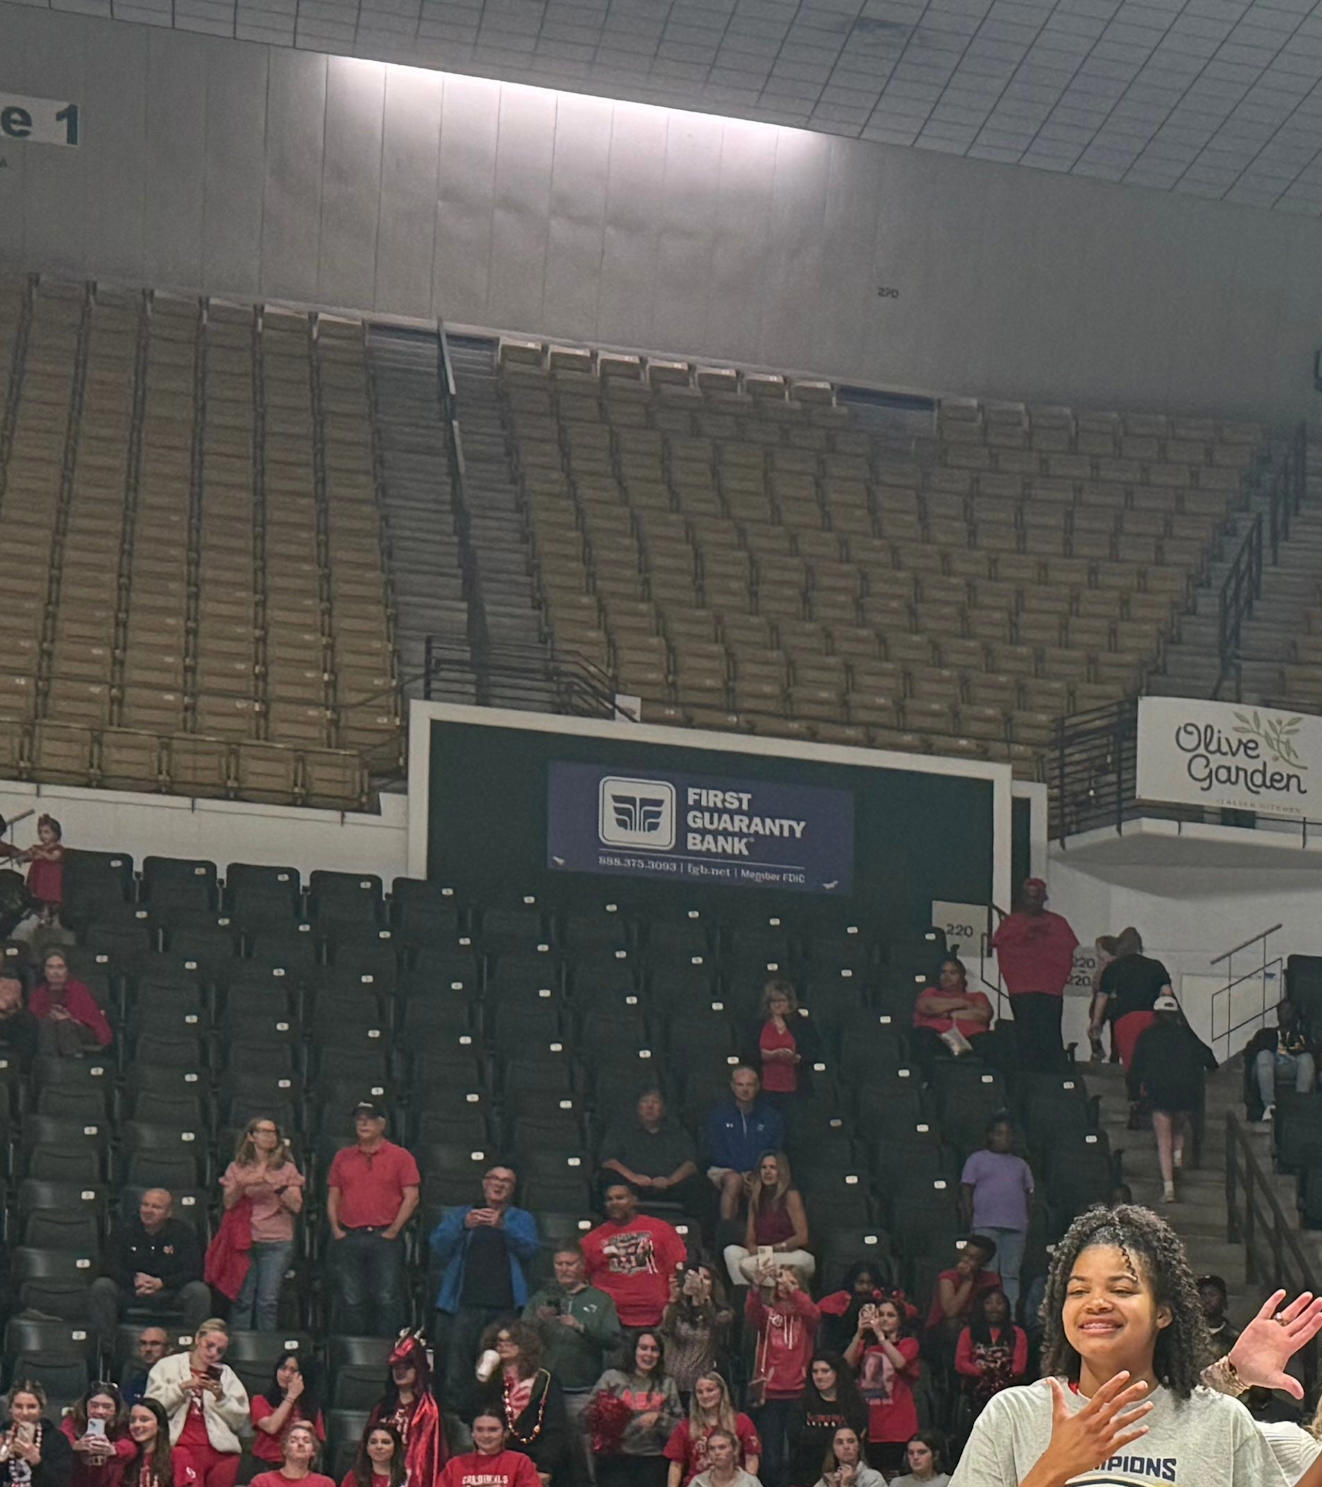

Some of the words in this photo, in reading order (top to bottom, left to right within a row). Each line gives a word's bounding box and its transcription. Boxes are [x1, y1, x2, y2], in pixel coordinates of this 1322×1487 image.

[1175, 722, 1260, 759] Olive
[1187, 754, 1308, 795] Garden
[687, 787, 752, 811] FIRST
[687, 810, 808, 839] GUARANTY
[687, 832, 750, 856] BANK
[946, 923, 974, 938] 220
